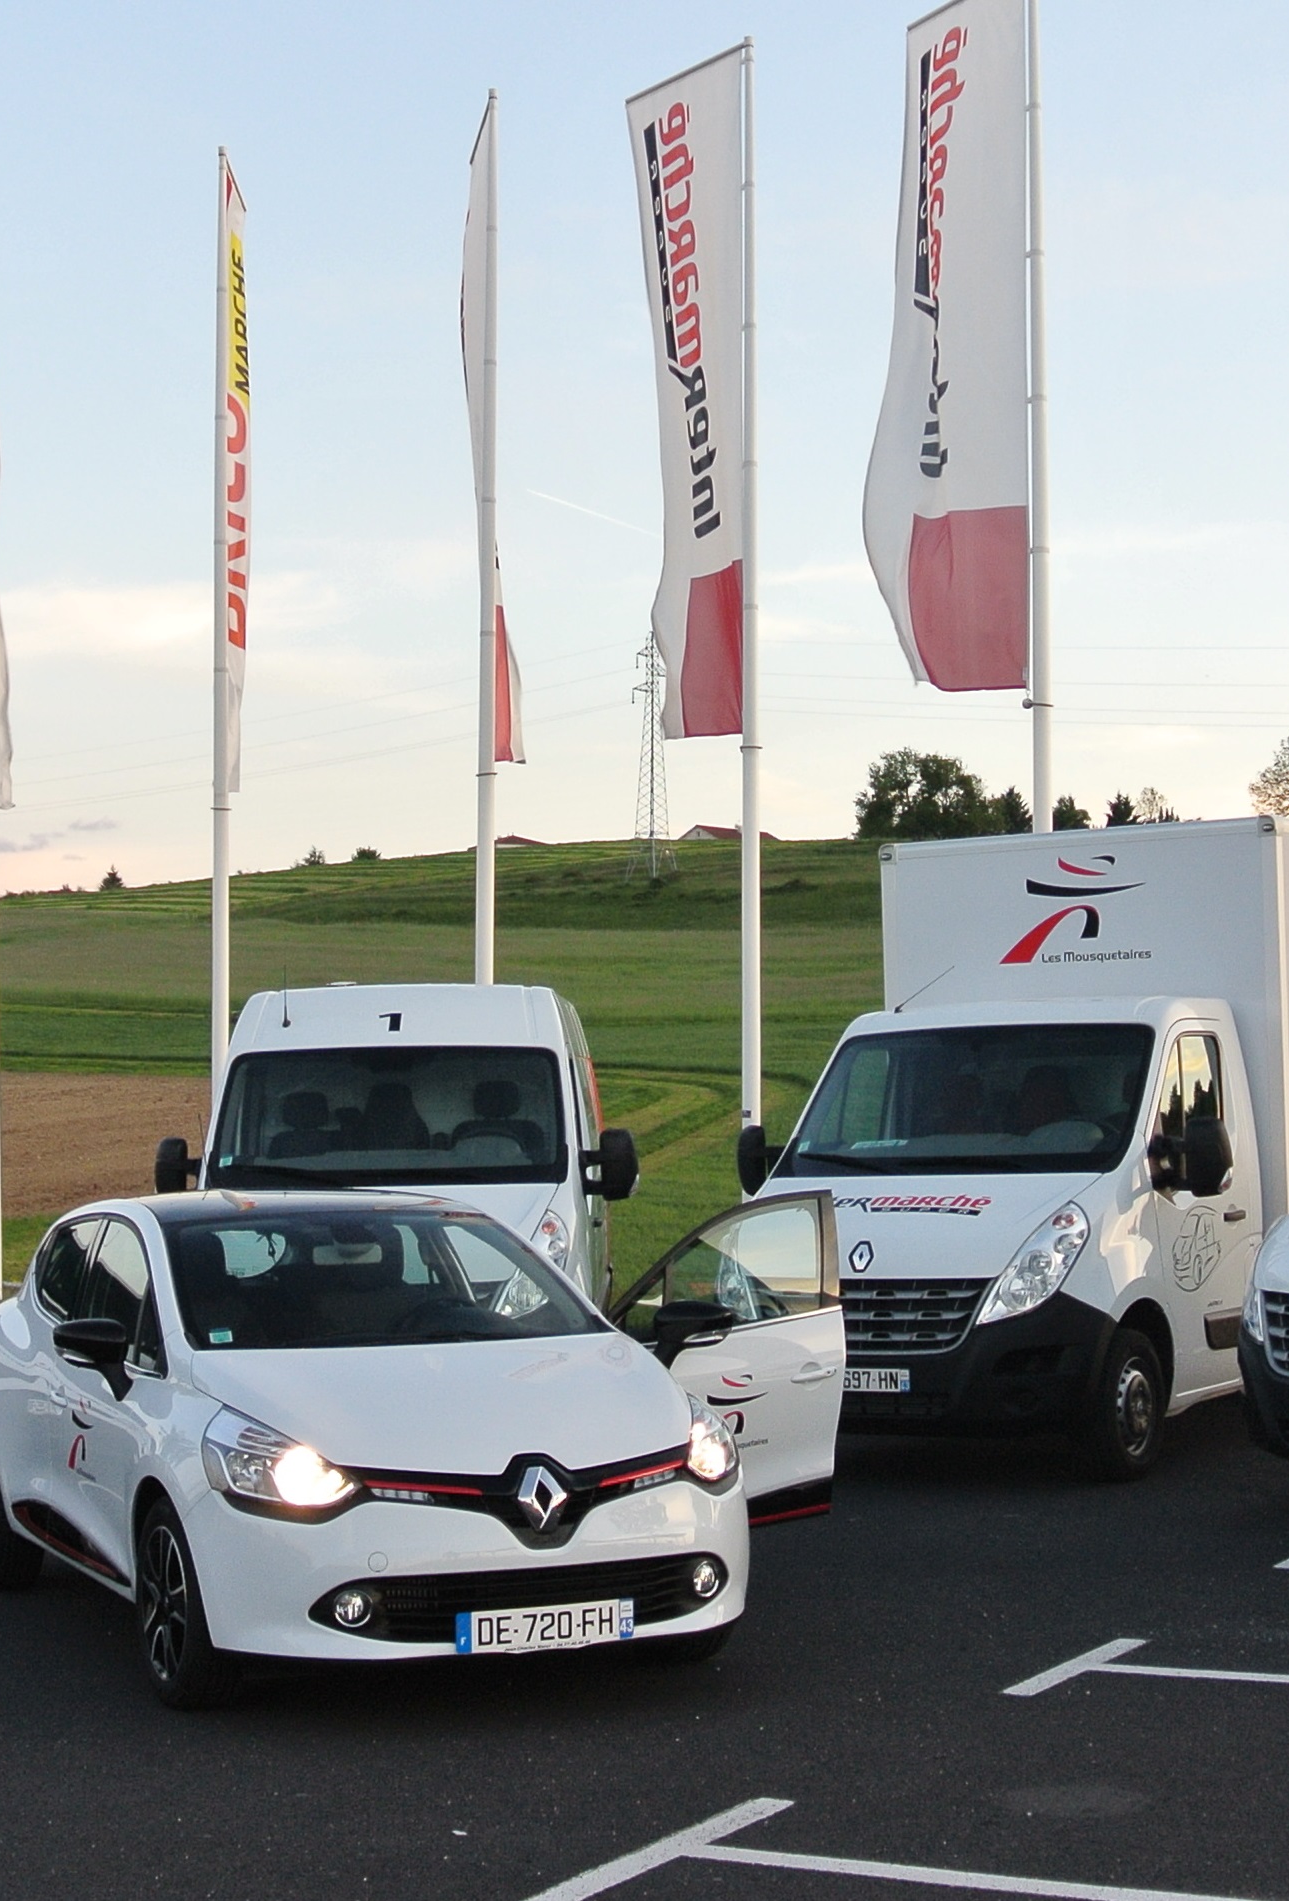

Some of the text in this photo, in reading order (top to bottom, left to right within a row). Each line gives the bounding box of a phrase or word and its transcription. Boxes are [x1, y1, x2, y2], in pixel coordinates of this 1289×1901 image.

[1042, 948, 1152, 963] Les Mousquetaires
[378, 1012, 402, 1032] 1
[478, 1605, 613, 1647] DE-720-FH
[619, 1618, 634, 1634] 43
